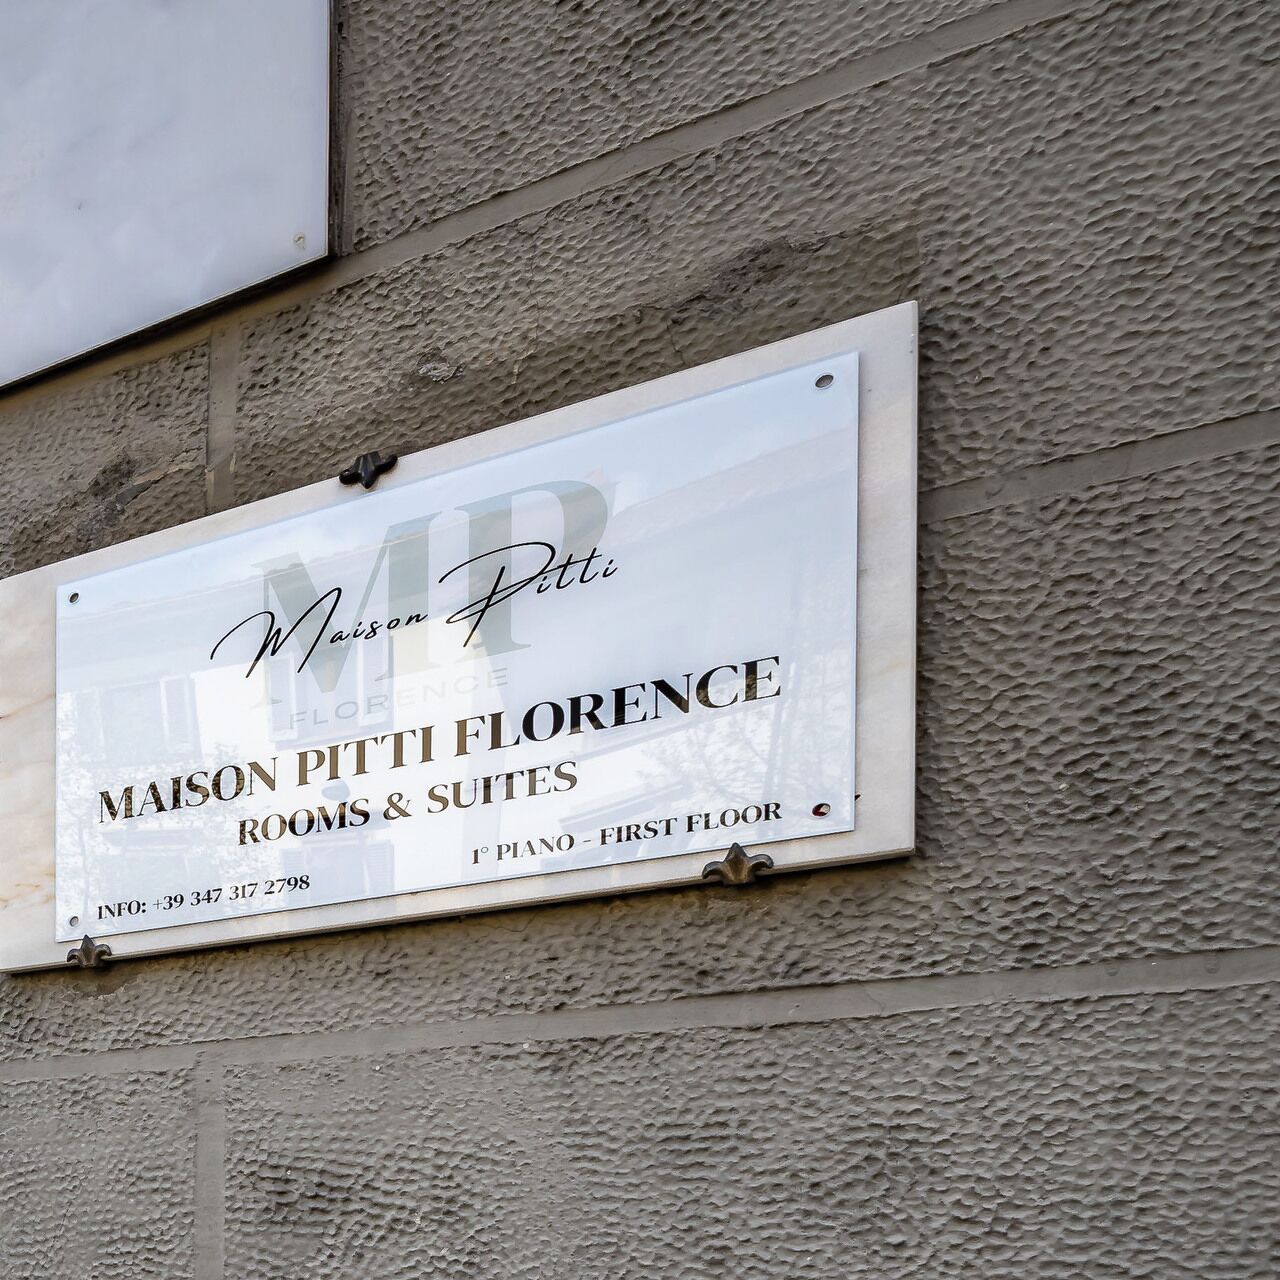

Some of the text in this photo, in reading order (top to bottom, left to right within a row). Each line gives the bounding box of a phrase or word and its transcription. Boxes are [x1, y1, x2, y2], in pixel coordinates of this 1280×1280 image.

[210, 541, 618, 678] Maison Pitti
[289, 666, 509, 730] FLORENCE
[98, 656, 782, 823] MAISON PITTI FLORENCE
[238, 761, 578, 845] ROOMS & SUITES
[472, 846, 489, 864] 1°
[497, 834, 575, 861] PIANO
[600, 818, 678, 845] FIRST
[686, 802, 783, 833] FLOOR
[98, 874, 311, 920] INFO: +39 347 317 2798
